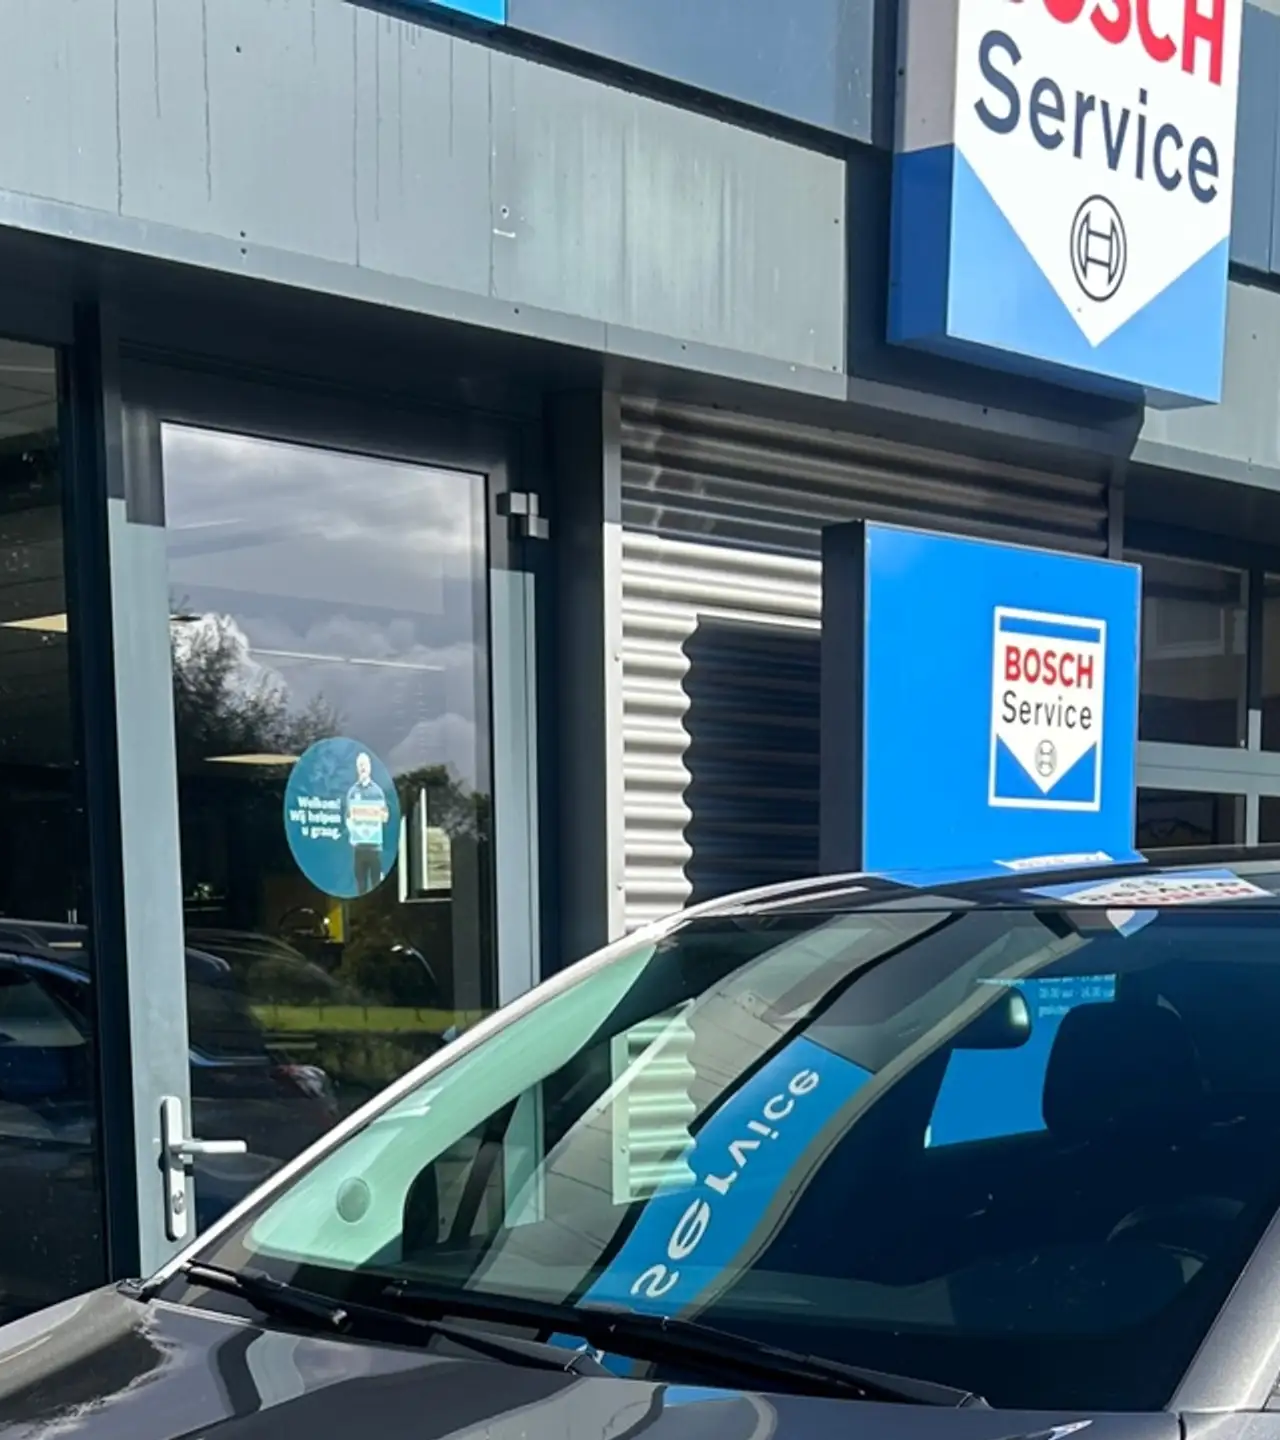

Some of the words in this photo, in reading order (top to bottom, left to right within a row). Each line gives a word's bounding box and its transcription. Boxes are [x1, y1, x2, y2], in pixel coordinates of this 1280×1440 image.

[974, 29, 1219, 204] Service
[1004, 645, 1094, 689] BOSCH
[1002, 690, 1093, 730] Service
